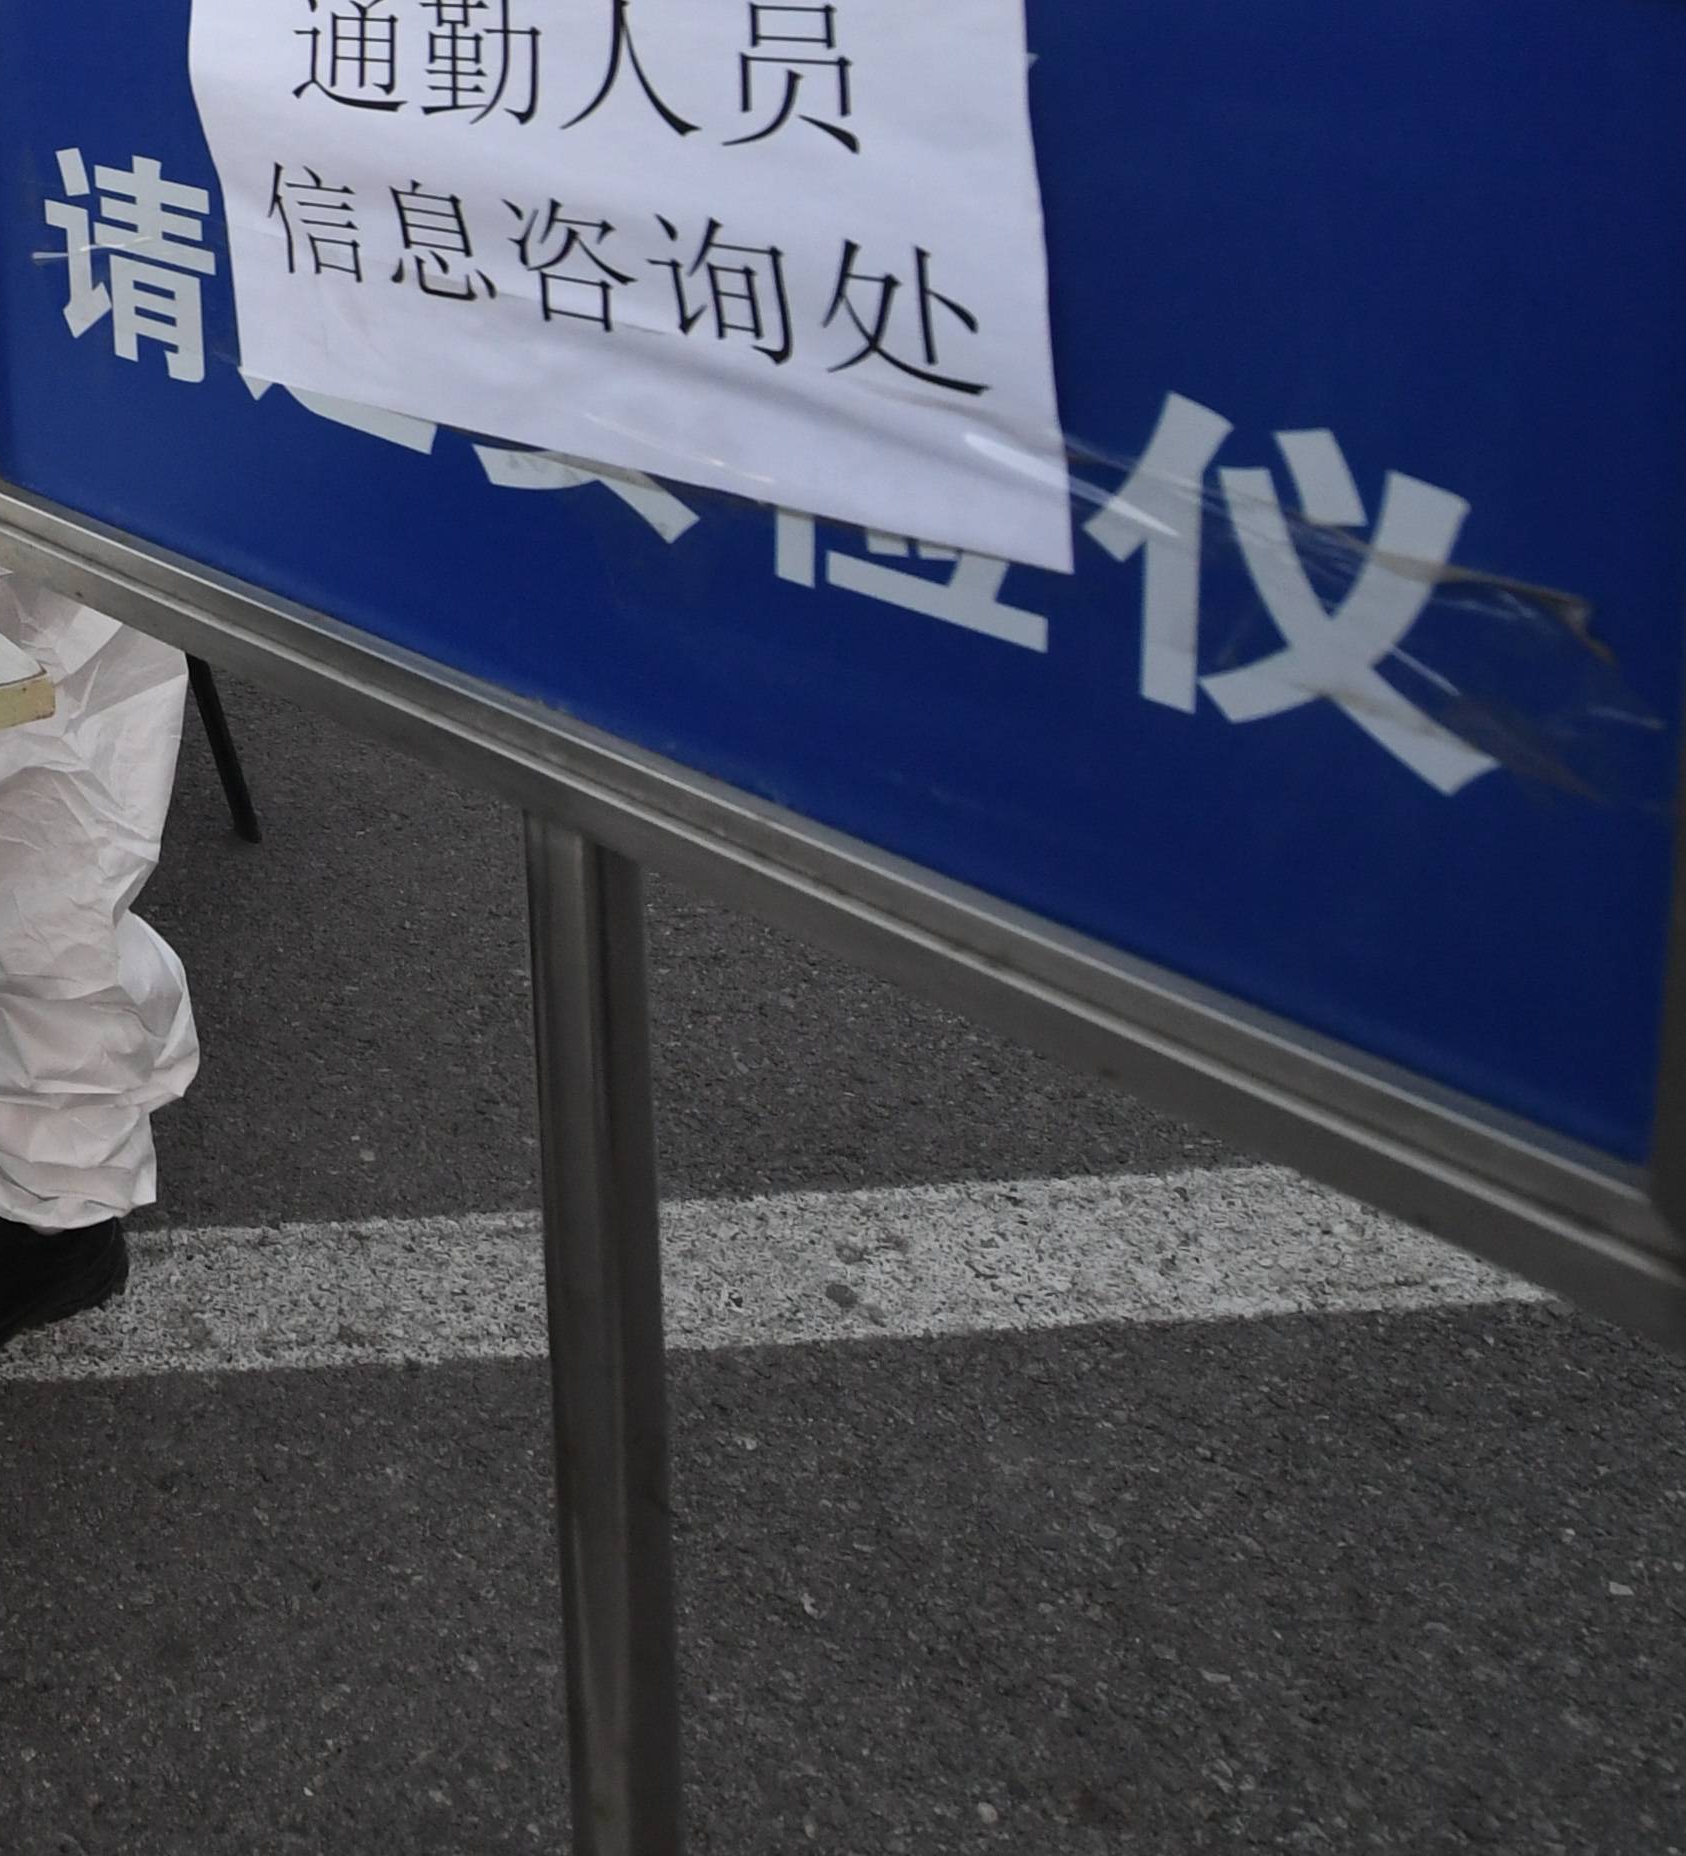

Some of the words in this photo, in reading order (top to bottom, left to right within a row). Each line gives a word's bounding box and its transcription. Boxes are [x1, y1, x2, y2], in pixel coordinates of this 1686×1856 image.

[265, 161, 991, 396] 信息咨询处
